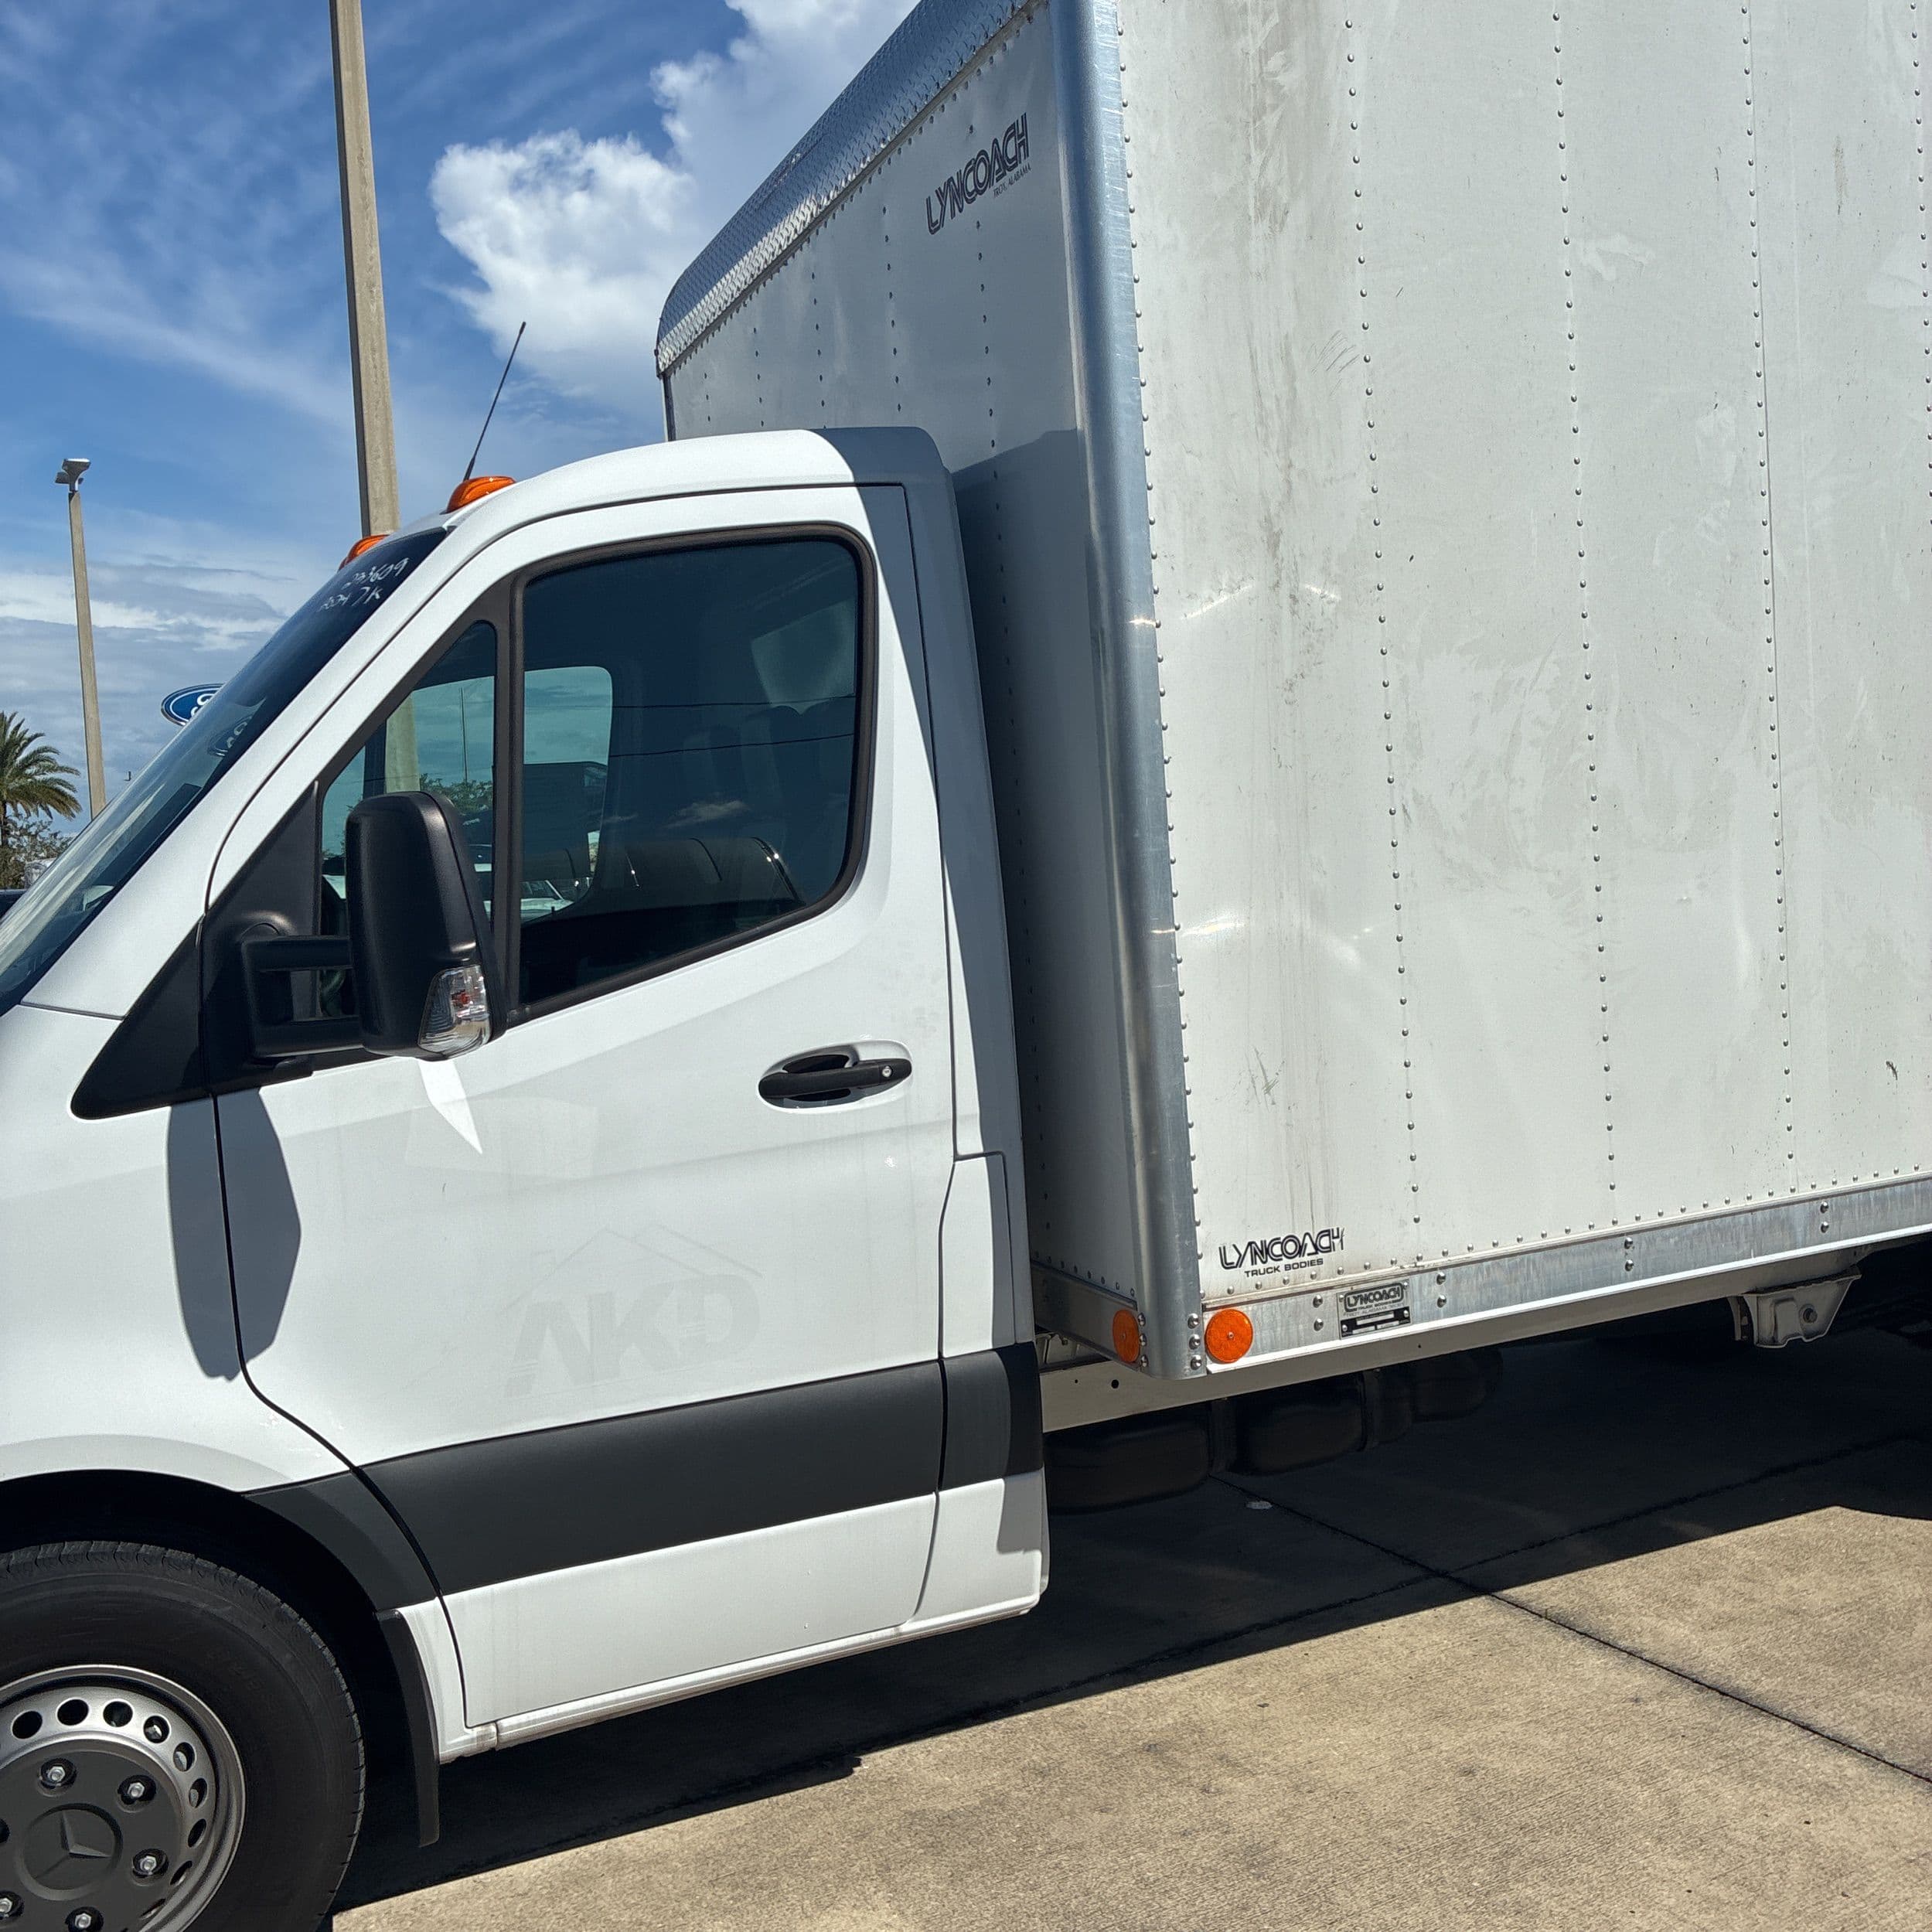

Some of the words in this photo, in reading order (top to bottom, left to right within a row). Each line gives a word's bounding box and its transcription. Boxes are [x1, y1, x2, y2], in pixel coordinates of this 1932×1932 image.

[925, 112, 1030, 235] LYNCOACH
[1218, 1227, 1345, 1269] LYNCOACH
[1244, 1266, 1280, 1278] TRUCK
[1284, 1258, 1324, 1272] BODIES
[1347, 1286, 1400, 1307] LYNCOACH
